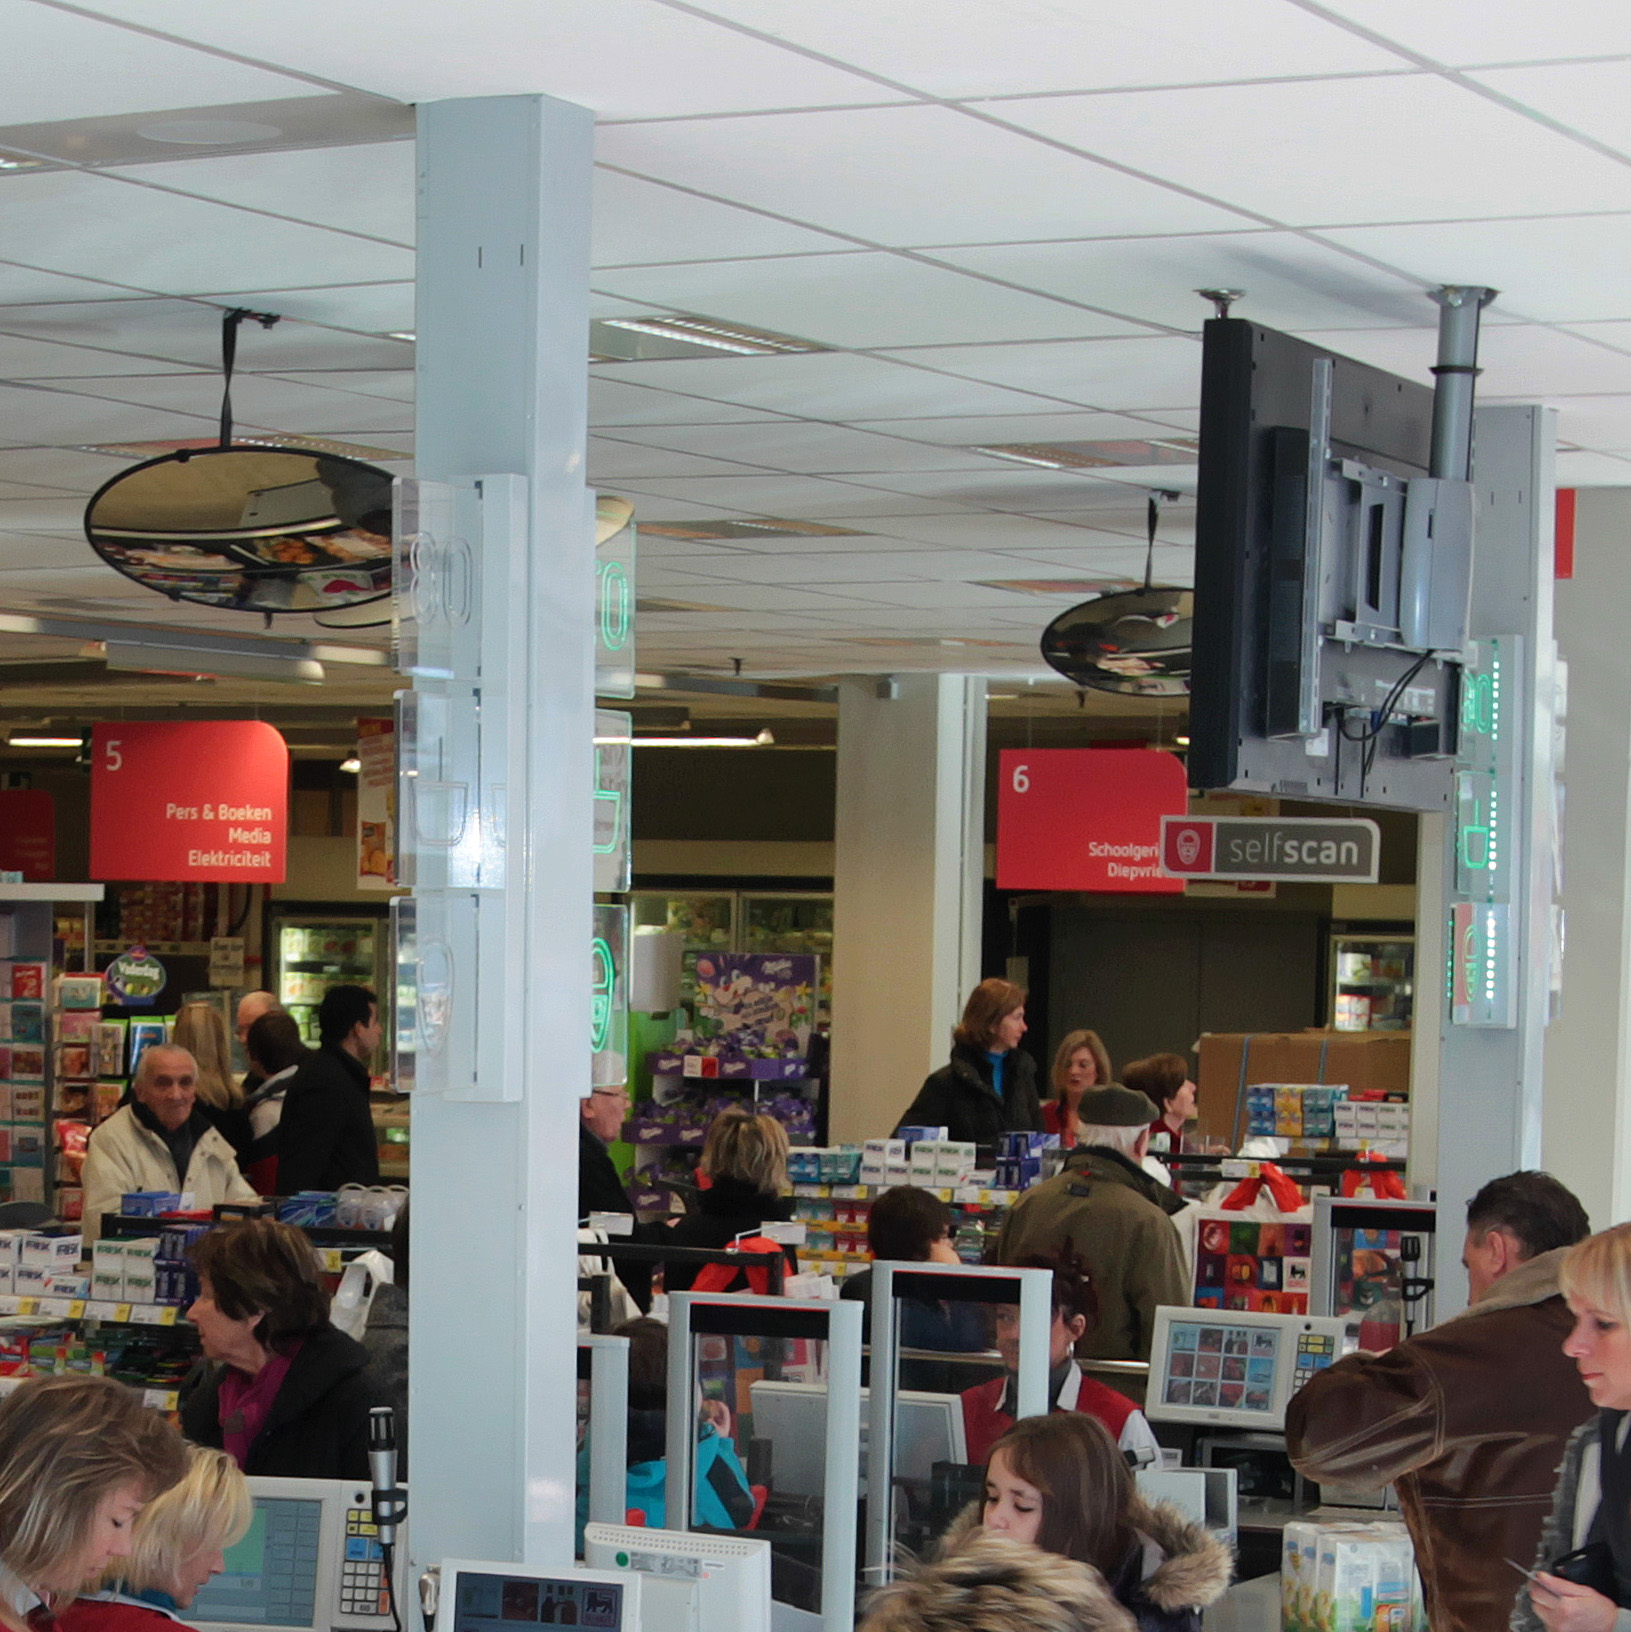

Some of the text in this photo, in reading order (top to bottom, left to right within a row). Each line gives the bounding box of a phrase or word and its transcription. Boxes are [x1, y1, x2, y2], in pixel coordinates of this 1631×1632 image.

[105, 740, 123, 771] 5
[1012, 765, 1031, 793] 6
[166, 803, 272, 821] Pers & Boeken
[228, 827, 272, 844] Media
[188, 850, 271, 867] Elektriciteit
[1088, 842, 1160, 862] Schoolgeri
[1229, 832, 1360, 866] selfscan
[1107, 862, 1164, 881] Diepvrie
